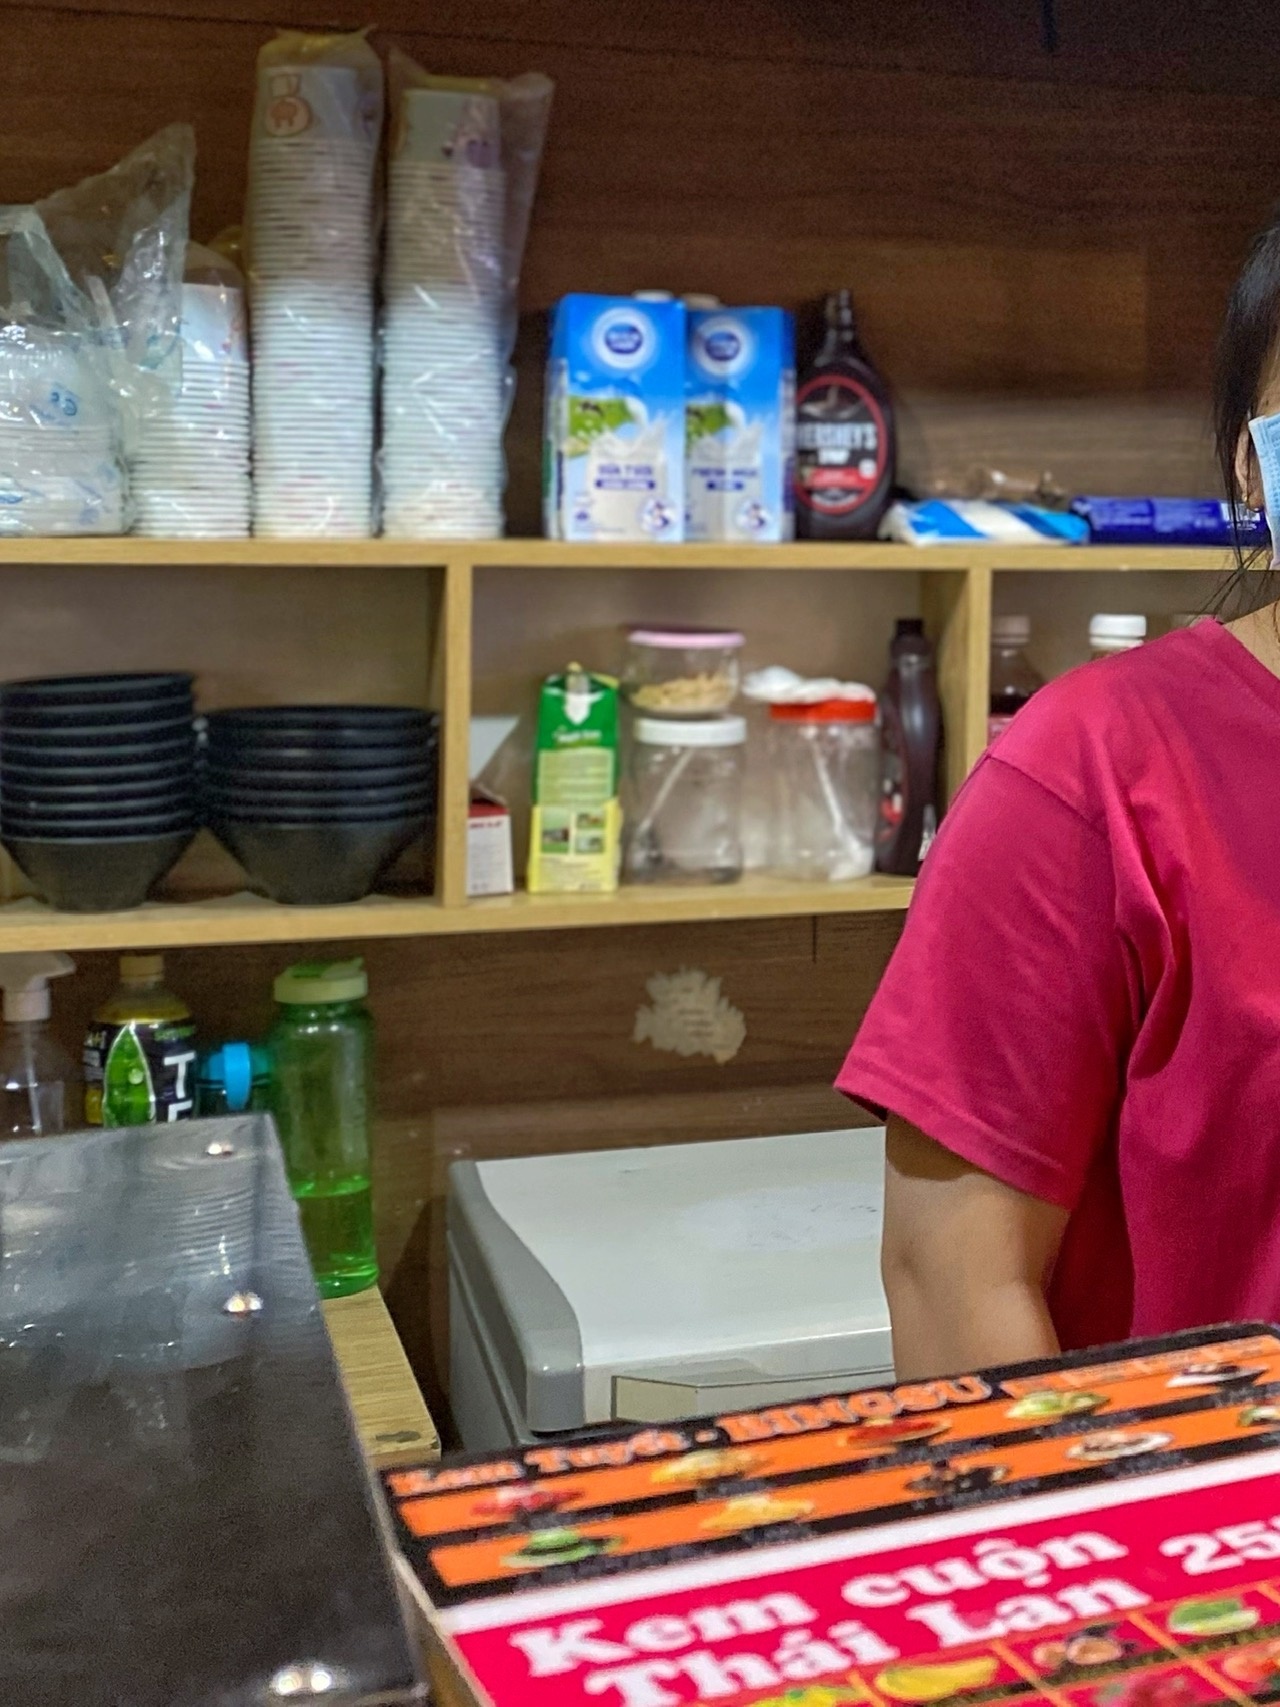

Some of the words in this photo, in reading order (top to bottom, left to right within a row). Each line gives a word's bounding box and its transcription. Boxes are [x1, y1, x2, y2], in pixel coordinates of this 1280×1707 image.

[508, 1592, 819, 1678] Kem
[841, 1531, 1129, 1608] cuộn
[584, 1619, 900, 1707] Thái
[905, 1577, 1152, 1648] Lan
